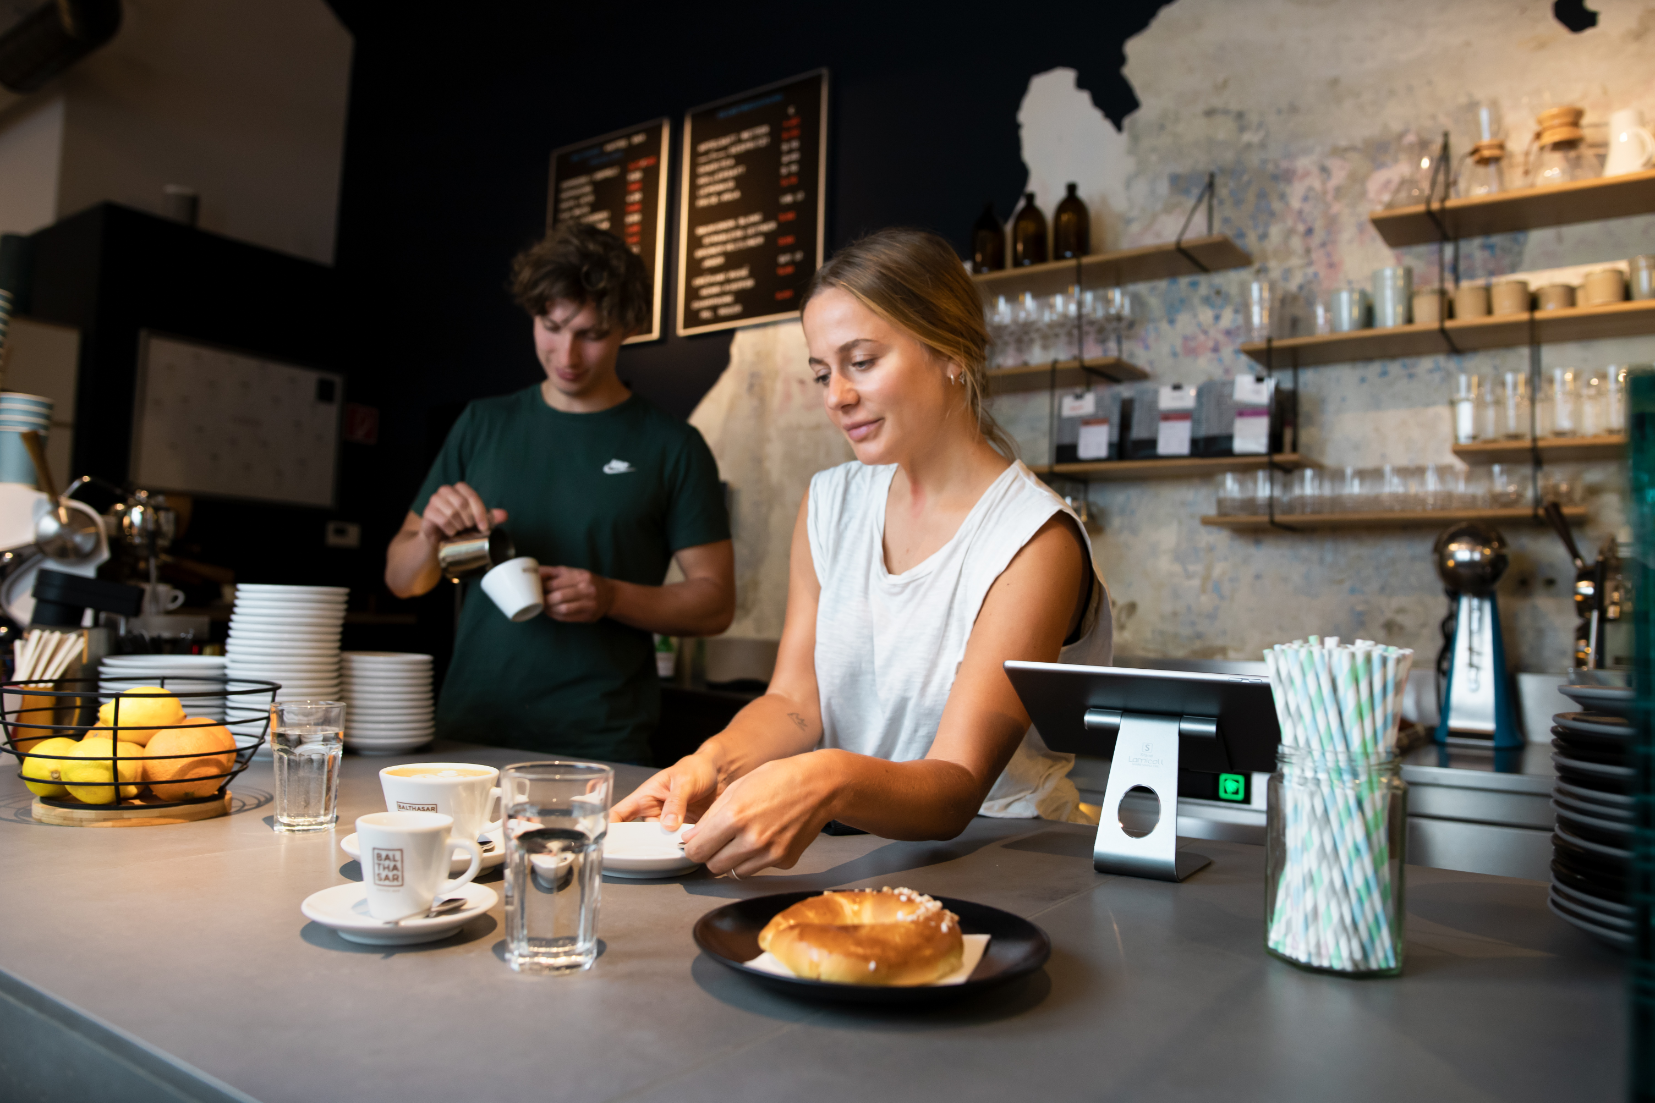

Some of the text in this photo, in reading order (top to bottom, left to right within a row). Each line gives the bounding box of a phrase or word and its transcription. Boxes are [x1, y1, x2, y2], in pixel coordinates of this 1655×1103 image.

[398, 804, 436, 812] BALTHASAR
[376, 853, 399, 862] BAL
[376, 863, 400, 872] THA
[376, 873, 400, 882] SAR
